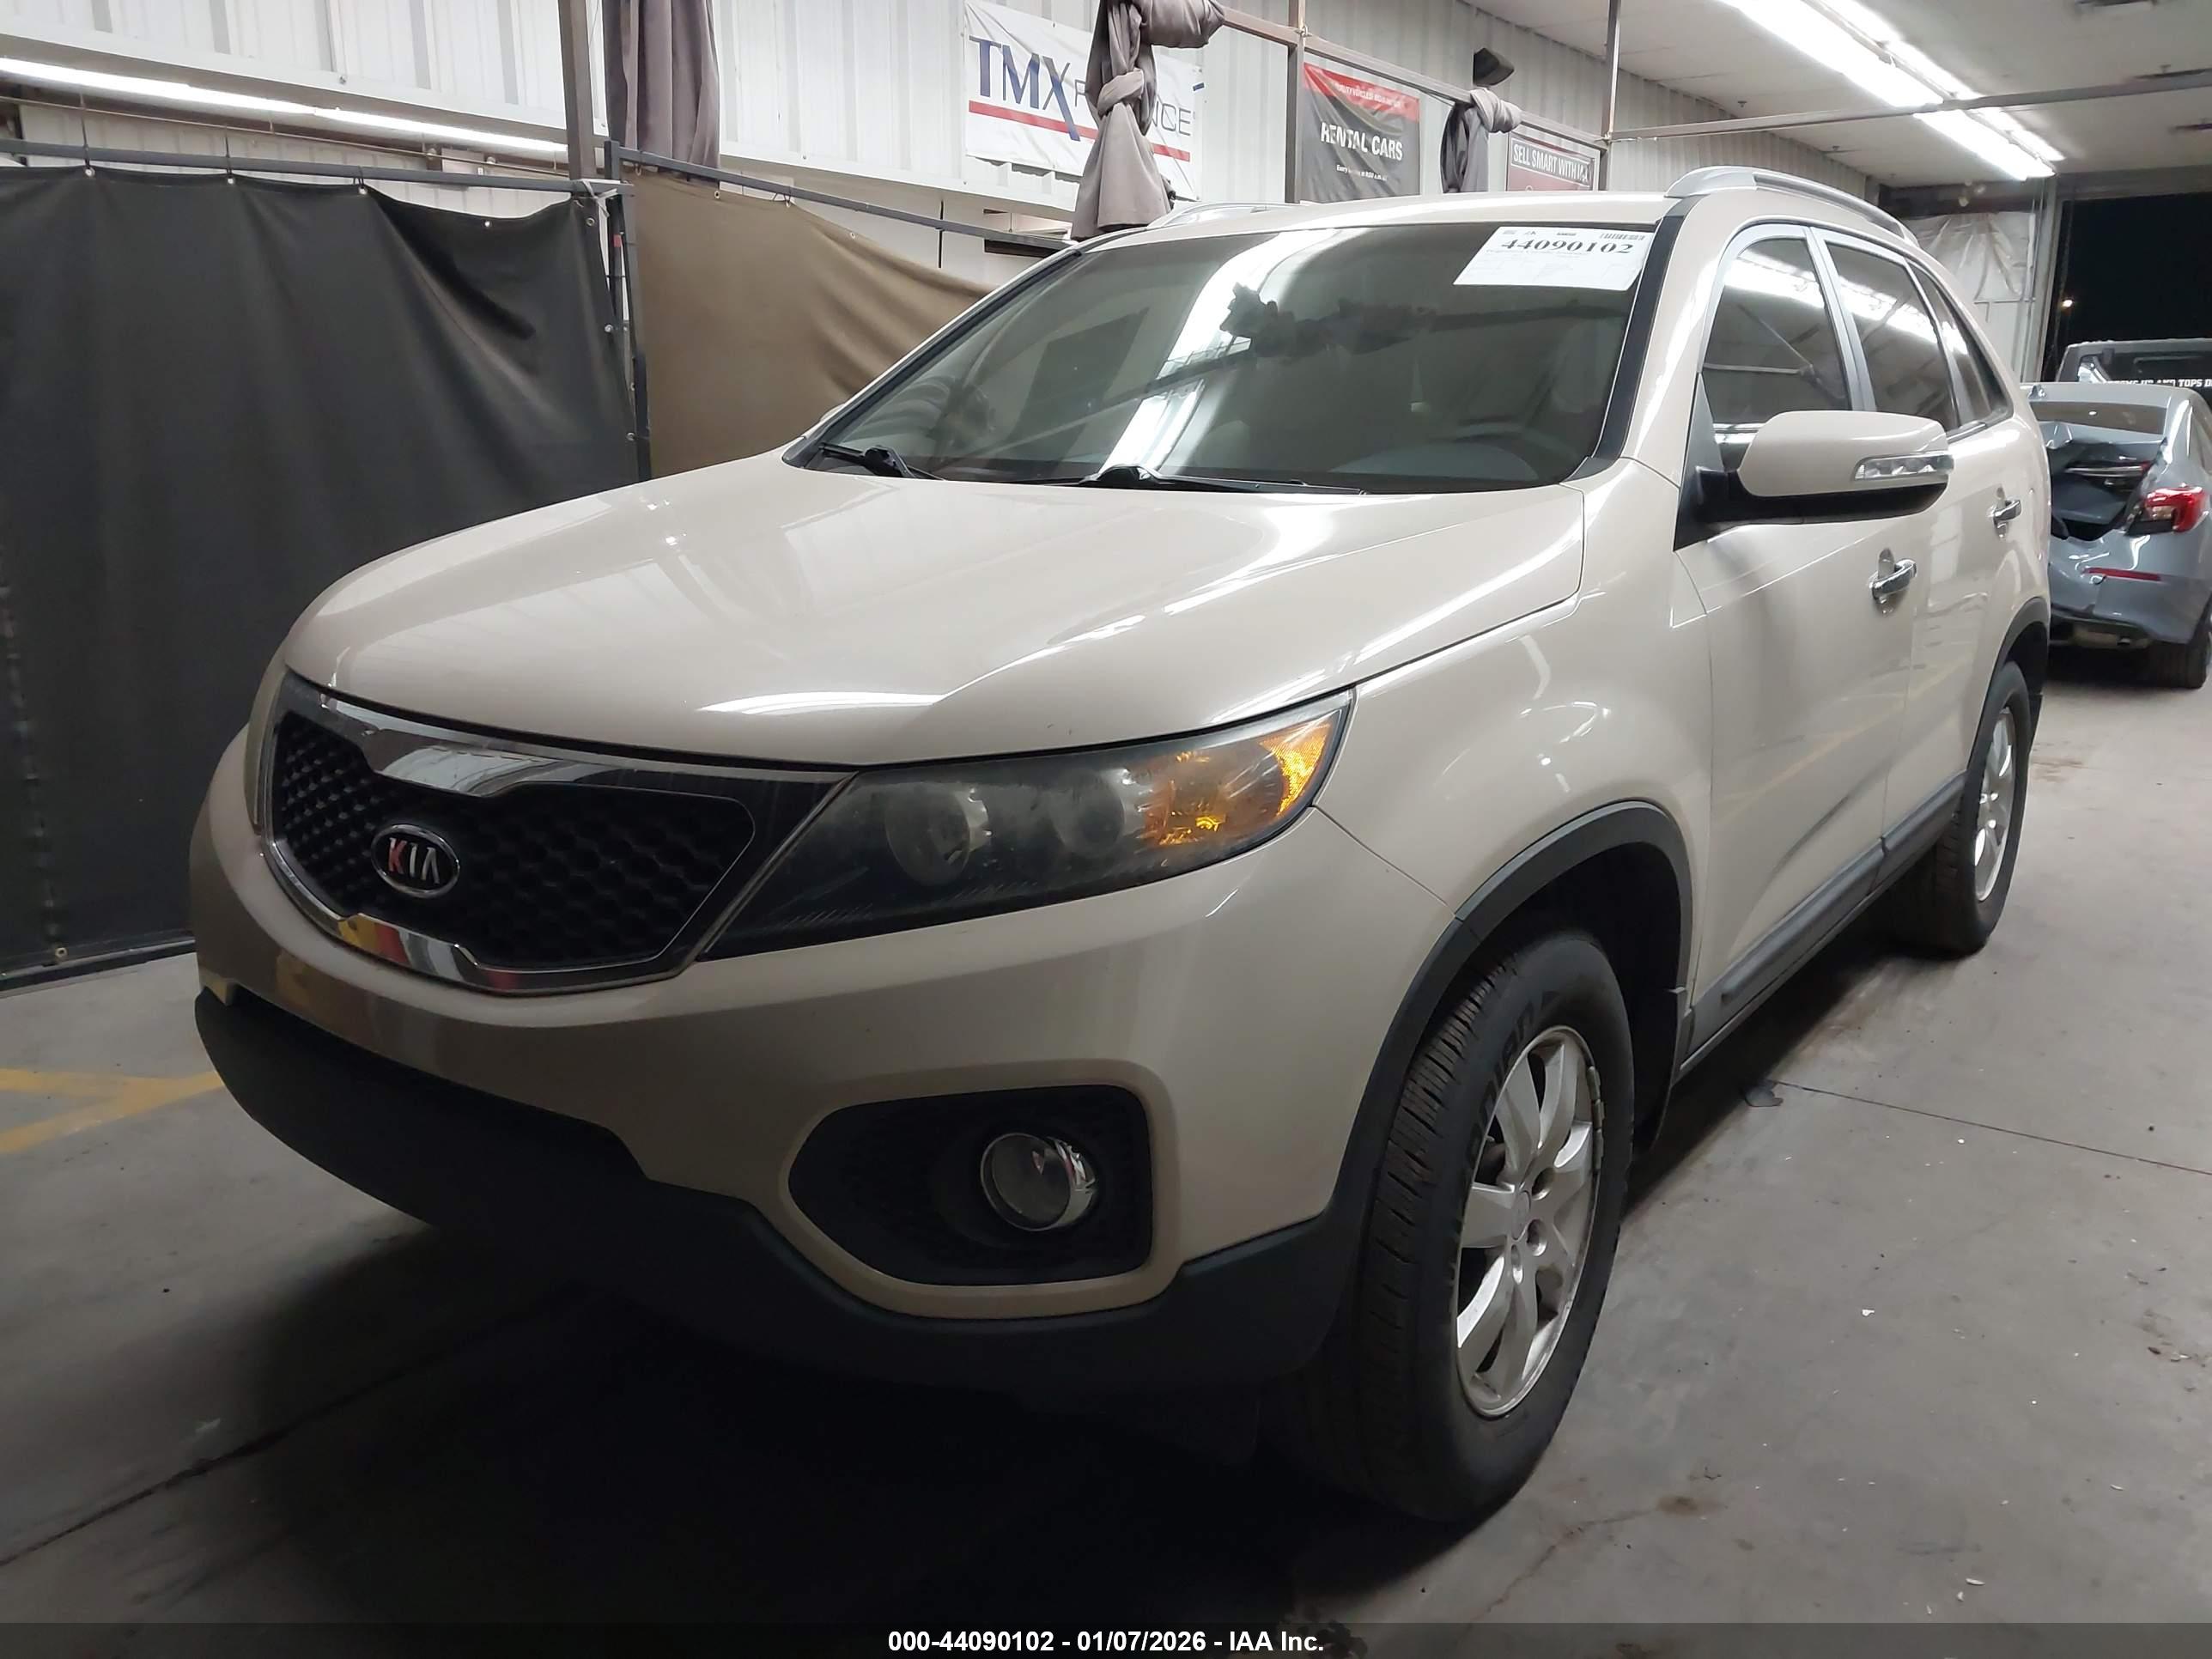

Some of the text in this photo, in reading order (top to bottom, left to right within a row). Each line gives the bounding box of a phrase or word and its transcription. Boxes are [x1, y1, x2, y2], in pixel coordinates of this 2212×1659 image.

[969, 34, 1081, 142] TMX
[1321, 122, 1403, 161] RENTAL CARS
[1513, 143, 1531, 166] SELL
[1531, 149, 1558, 173] SMART
[1558, 158, 1577, 179] WITH
[1500, 239, 1635, 254] 44090102
[2178, 379, 2203, 387] TOPS
[388, 837, 441, 884] KIA
